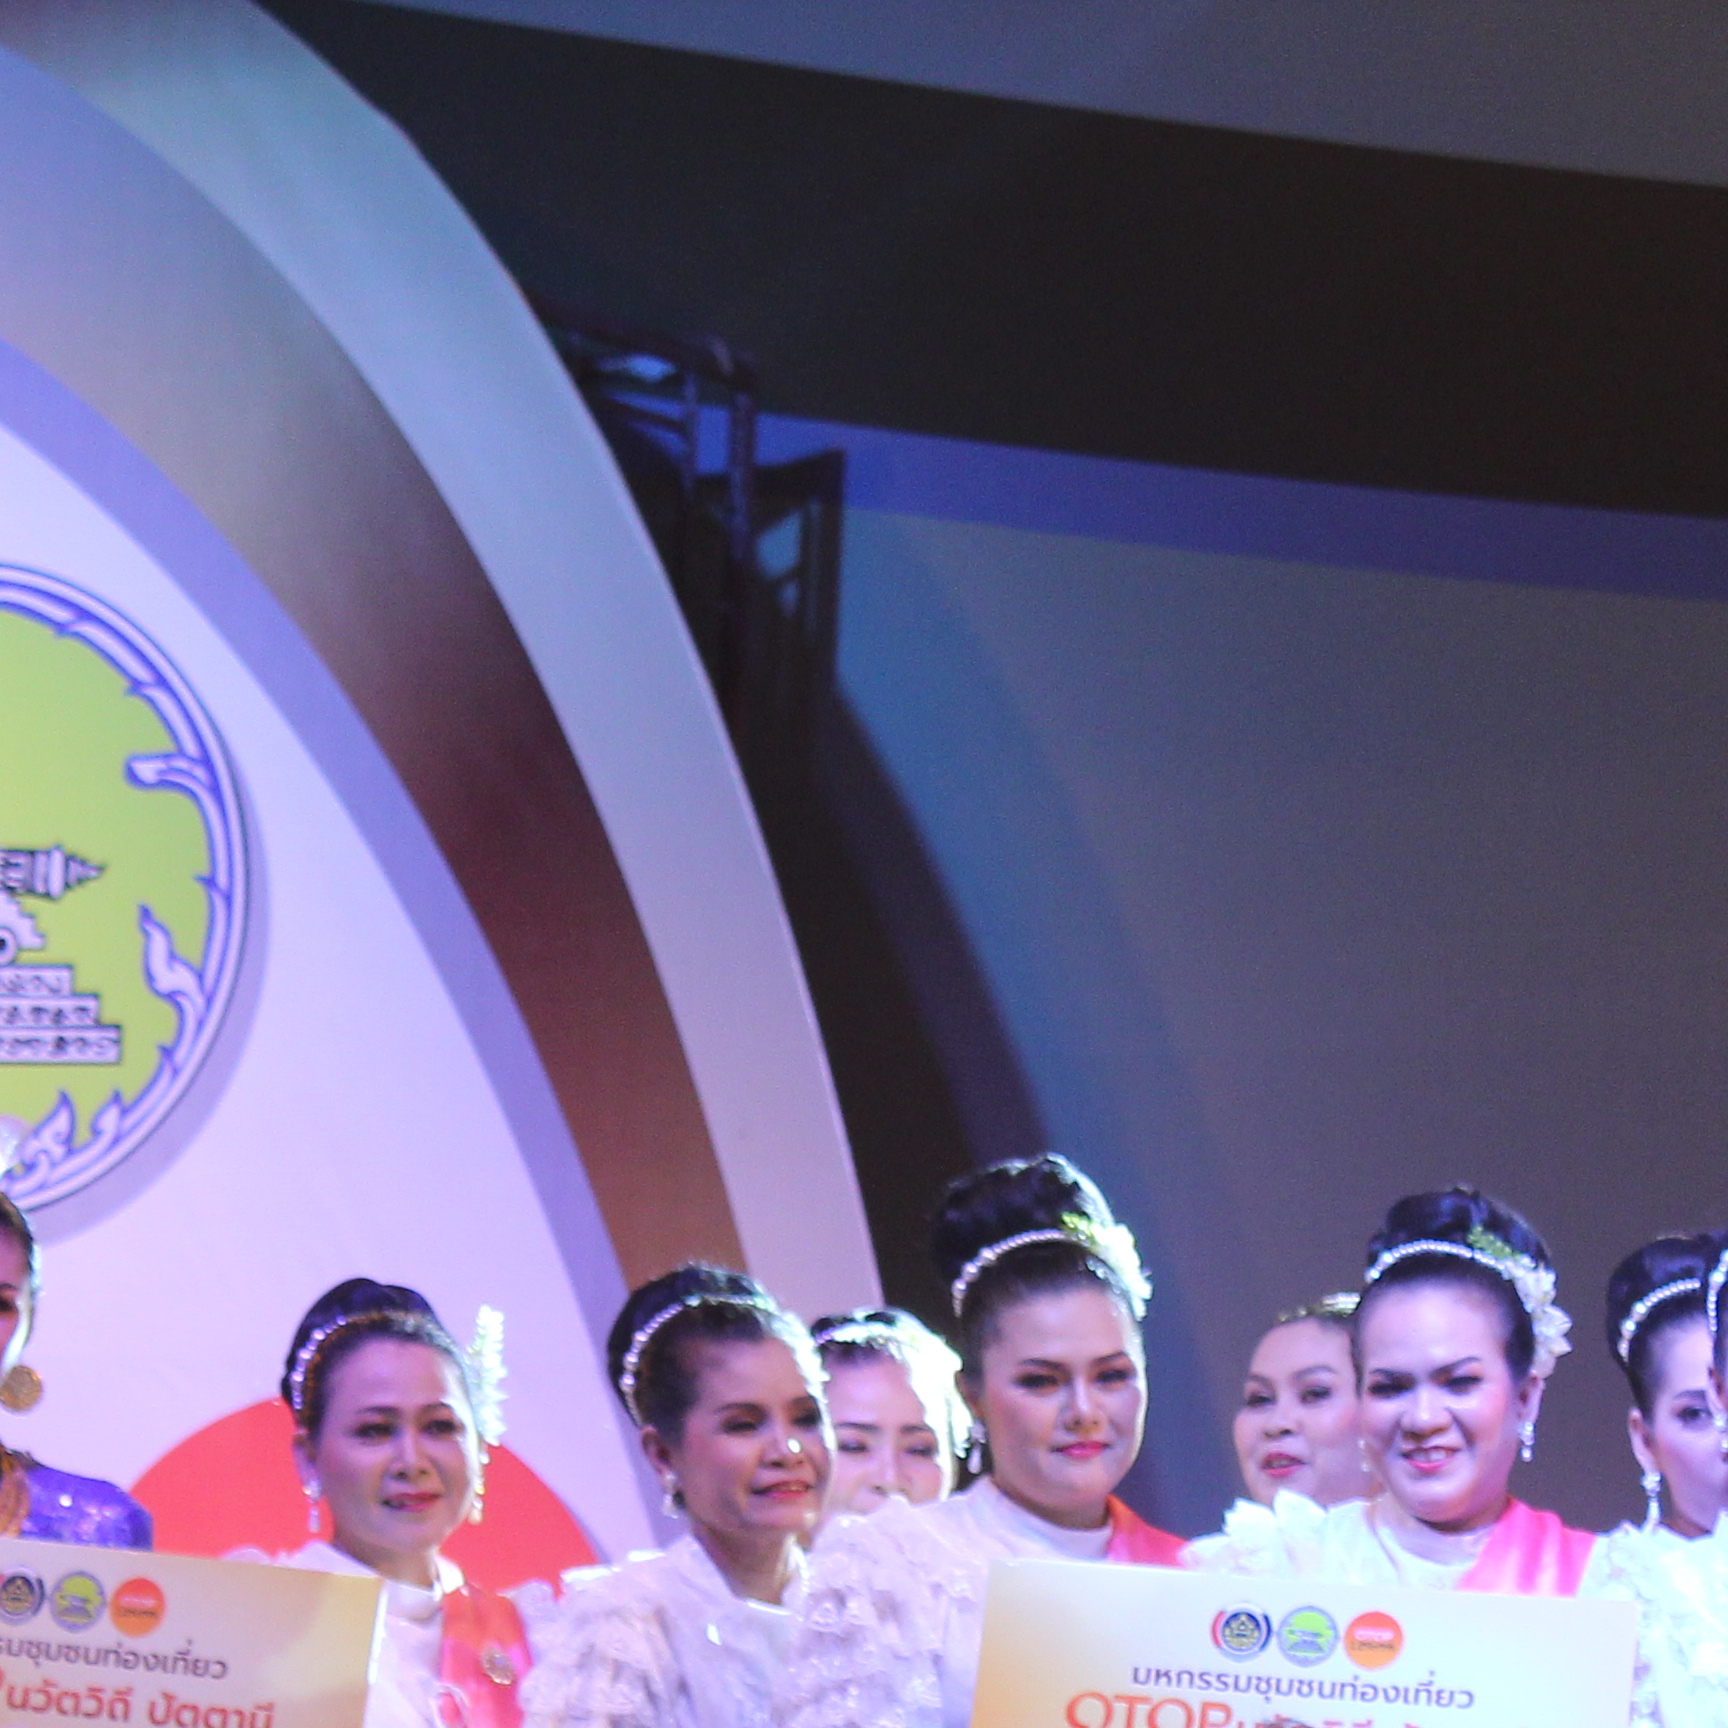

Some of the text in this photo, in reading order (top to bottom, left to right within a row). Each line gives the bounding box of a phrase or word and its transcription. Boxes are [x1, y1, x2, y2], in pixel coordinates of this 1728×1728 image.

[1132, 1664, 1475, 1710] มหกรรมชุมชนท่องเที่ยว
